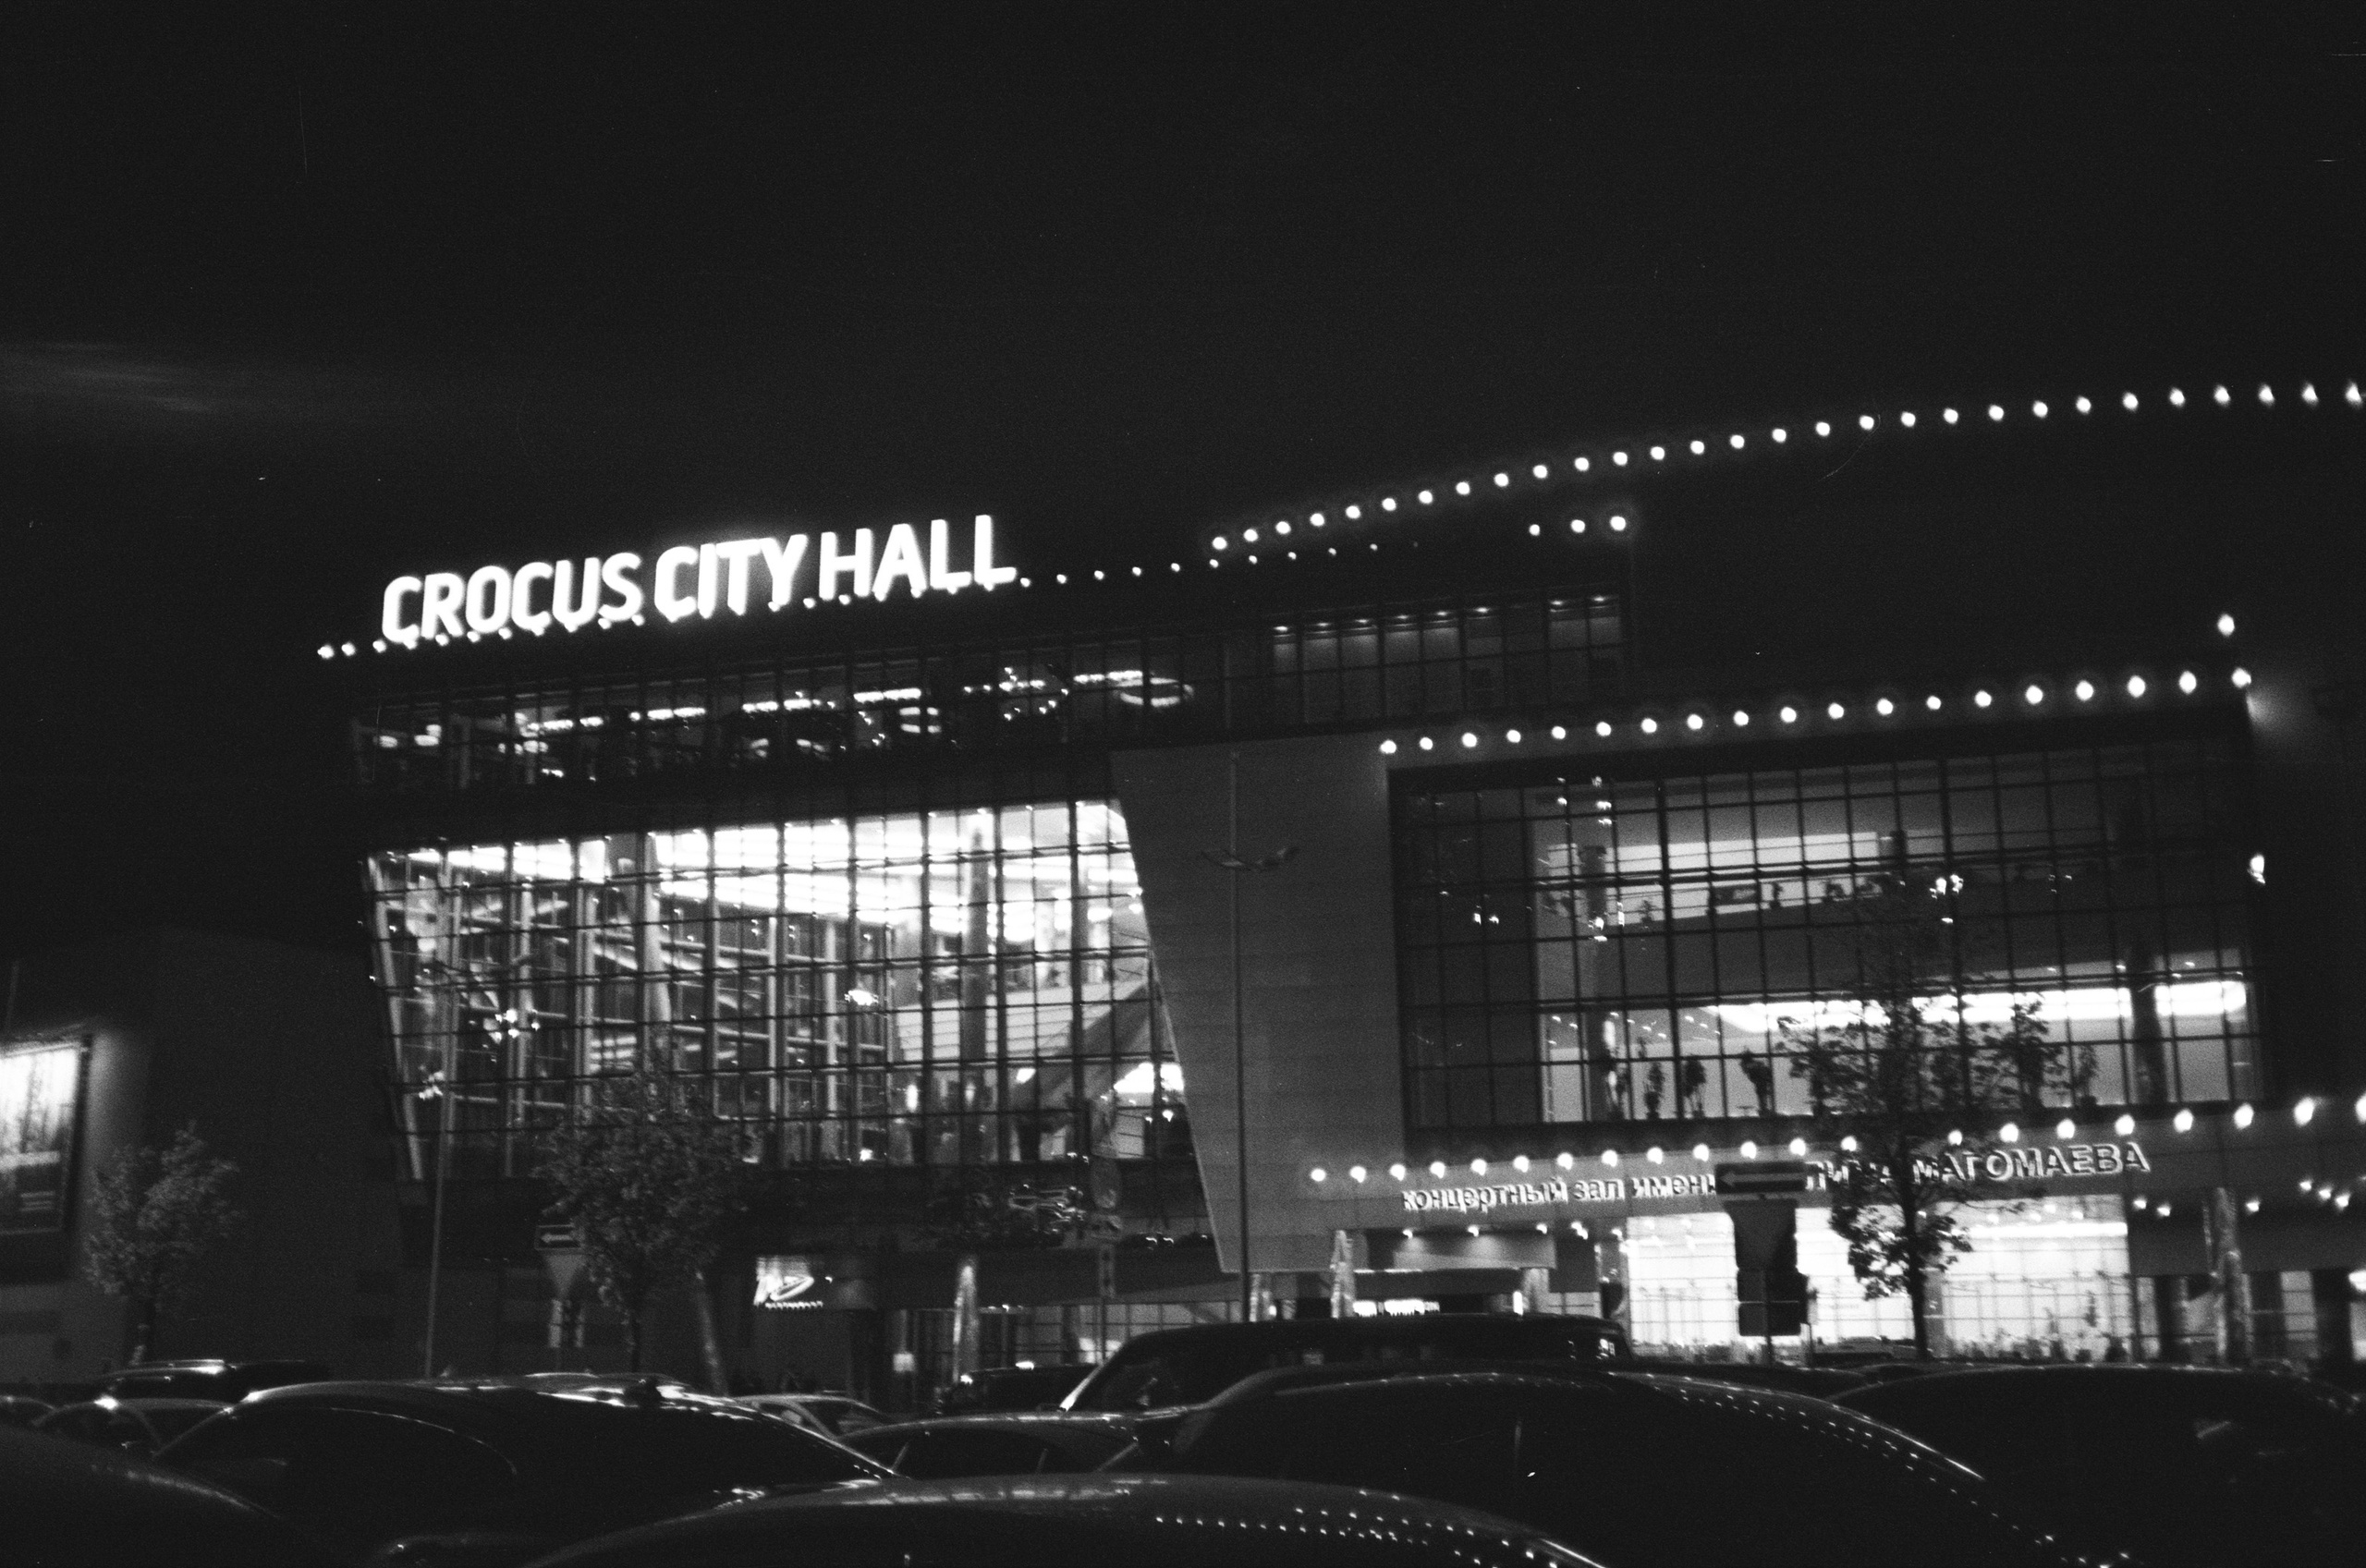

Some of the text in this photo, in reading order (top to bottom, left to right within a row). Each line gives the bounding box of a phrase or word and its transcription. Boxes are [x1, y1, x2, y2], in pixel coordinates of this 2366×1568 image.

[381, 514, 1018, 645] CROCUS CITY HALL
[1402, 1176, 1569, 1213] концертный
[1573, 1178, 1625, 1202] зал
